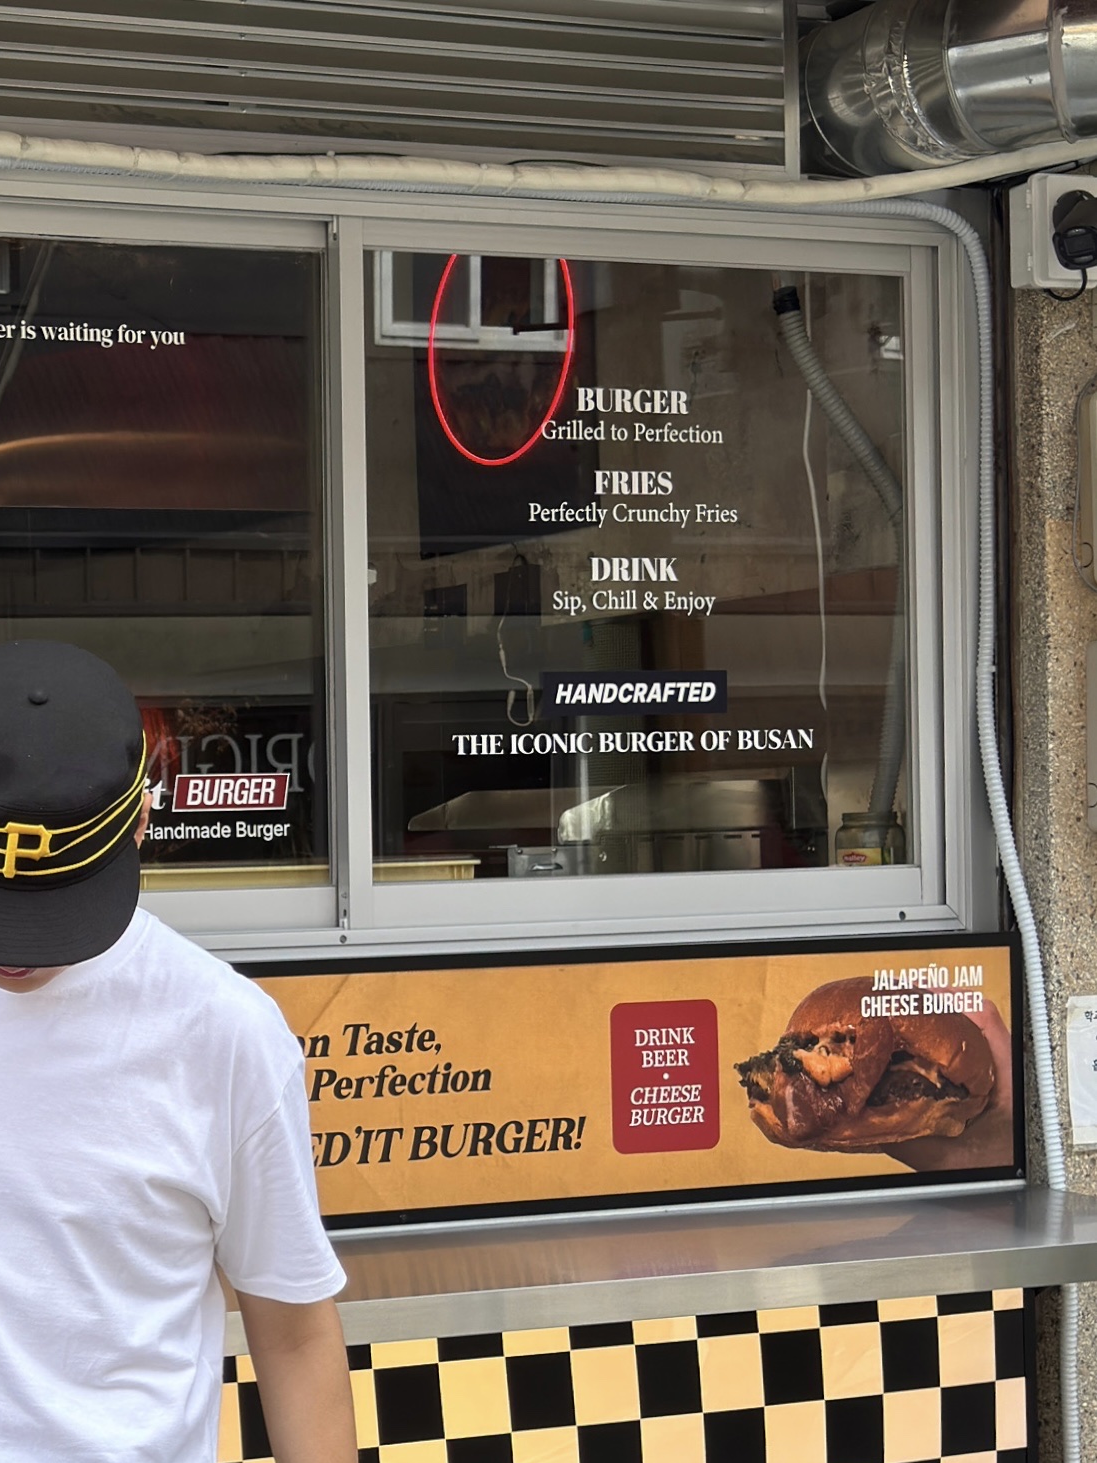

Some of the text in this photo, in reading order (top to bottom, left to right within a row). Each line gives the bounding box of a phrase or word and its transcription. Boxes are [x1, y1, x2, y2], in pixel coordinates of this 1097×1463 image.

[20, 319, 37, 340] is
[40, 322, 114, 348] waiting
[117, 323, 147, 344] for
[150, 330, 185, 350] you
[577, 387, 689, 415] BURGER
[540, 419, 723, 444] Grilled to Perfection
[594, 470, 673, 496] FRIES
[528, 501, 738, 529] Perfectly Crunchy Fries
[591, 557, 678, 582] DRINK
[552, 589, 716, 617] Sip, Chill & Enjoy
[555, 681, 716, 705] HANDCRAFTED
[451, 728, 814, 756] THE ICONIC BURGER OF BUSAN
[186, 778, 277, 806] BURGER
[235, 820, 291, 842] Burger
[3, 822, 53, 879] P
[871, 962, 983, 991] JALAPEÑO JAM
[861, 990, 984, 1018] CHEESE BURGER
[342, 1022, 442, 1057] Taste,
[634, 1026, 695, 1047] DRINK
[641, 1048, 690, 1068] BEER
[308, 1062, 492, 1102] Perfection
[630, 1084, 702, 1105] CHEESE
[629, 1105, 705, 1127] BURGER
[407, 1115, 587, 1161] BURGER!
